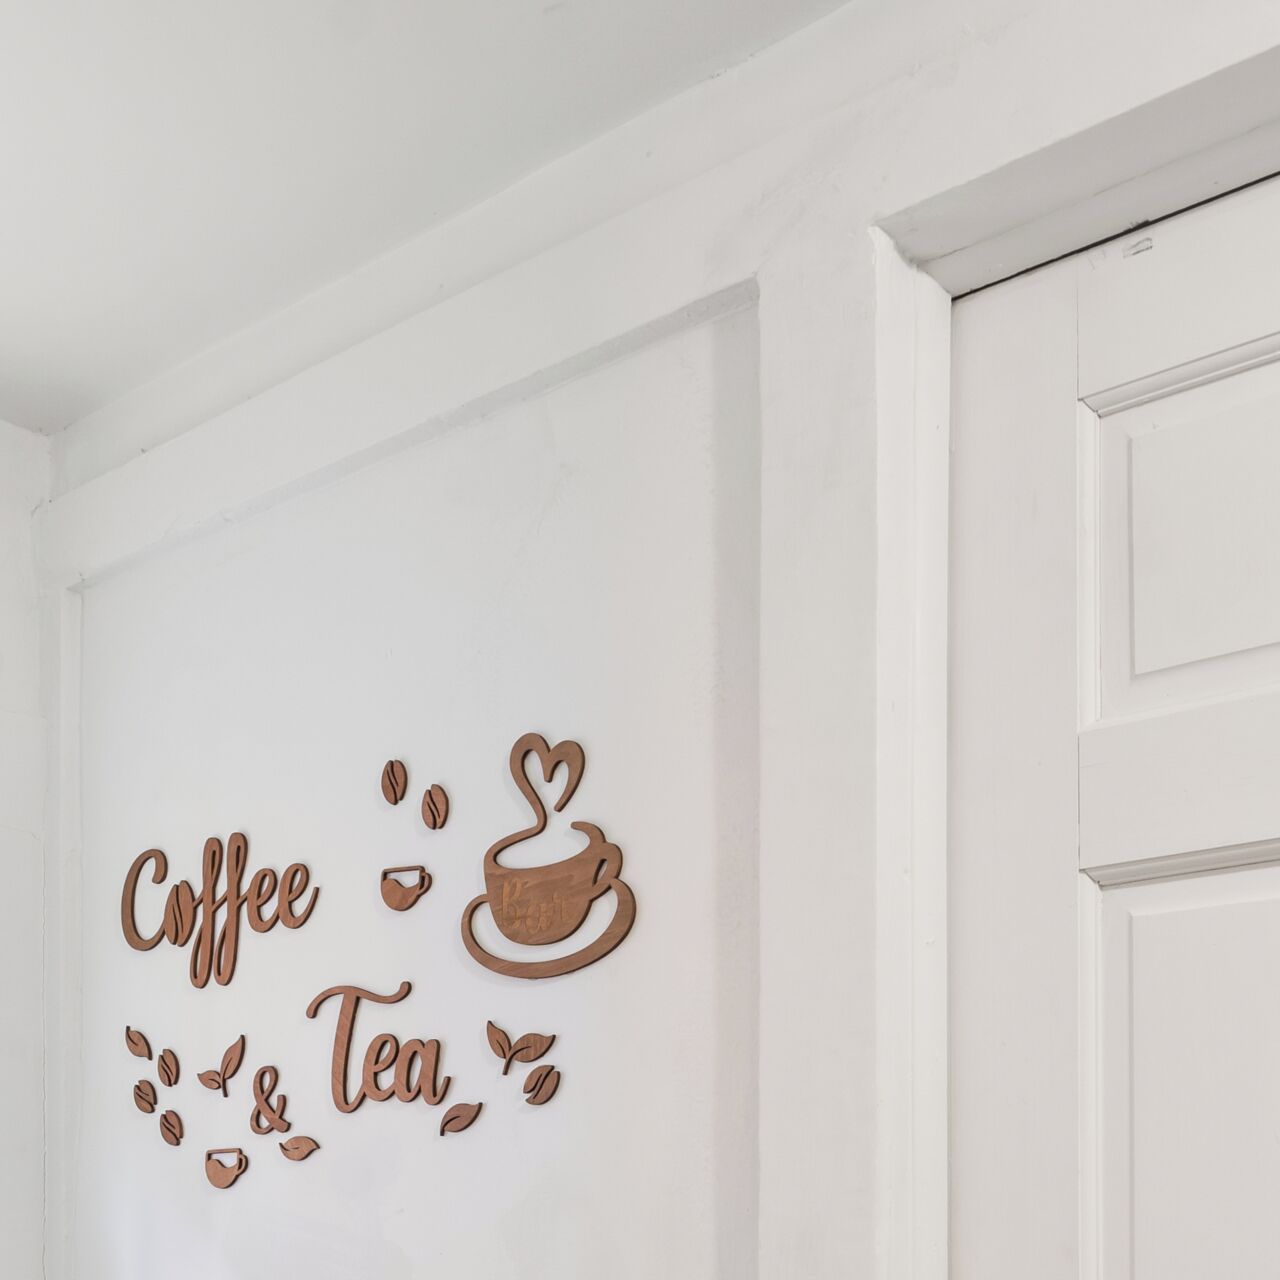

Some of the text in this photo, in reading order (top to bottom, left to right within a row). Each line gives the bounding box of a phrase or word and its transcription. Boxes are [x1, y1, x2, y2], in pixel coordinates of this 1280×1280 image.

[120, 831, 321, 990] Coffee
[249, 980, 453, 1136] & Tea
